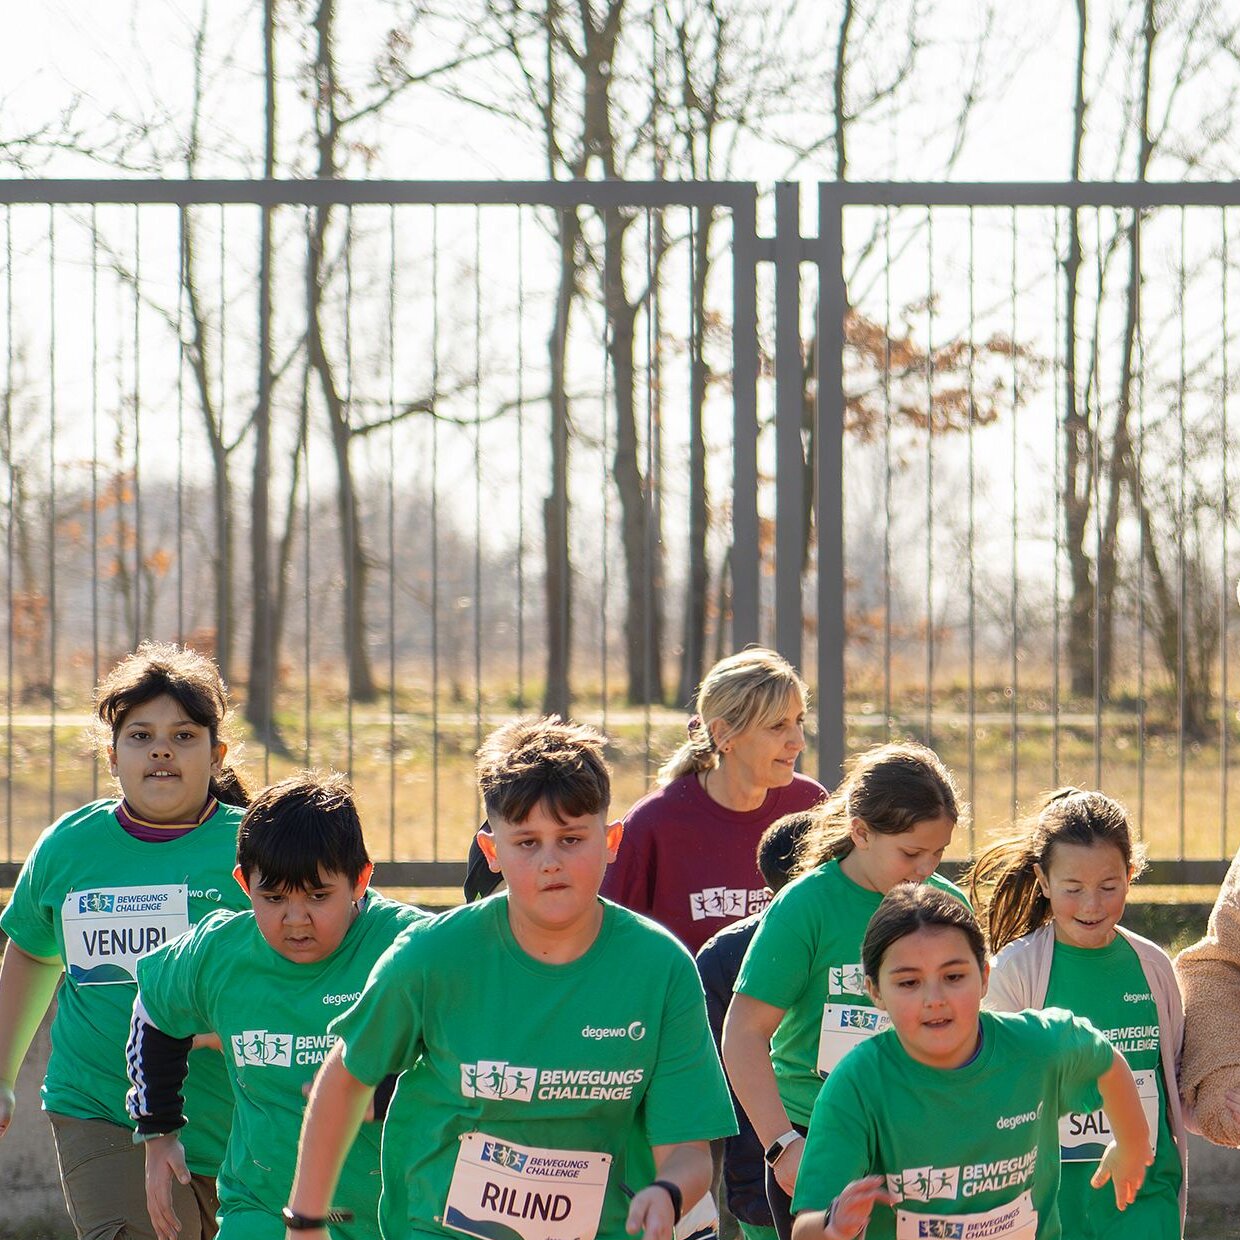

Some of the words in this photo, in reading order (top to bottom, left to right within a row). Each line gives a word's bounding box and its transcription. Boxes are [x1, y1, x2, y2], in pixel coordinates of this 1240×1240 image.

[117, 893, 168, 903] BEWEGUNGS
[115, 902, 162, 912] CHALLENGE
[82, 926, 167, 956] VENURI
[322, 992, 361, 1006] degewo
[581, 1025, 626, 1040] degewo
[539, 1069, 644, 1085] BEWEGUNGS
[537, 1086, 633, 1101] CHALLENGE
[996, 1111, 1037, 1130] degewo
[1069, 1110, 1111, 1136] SAL
[529, 1157, 590, 1170] BEWEGUNGS
[525, 1166, 580, 1179] CHALLENGE
[480, 1181, 572, 1222] RILIND
[967, 1206, 1020, 1232] BEWEGUNGS
[965, 1218, 1015, 1240] CHALLENGE
